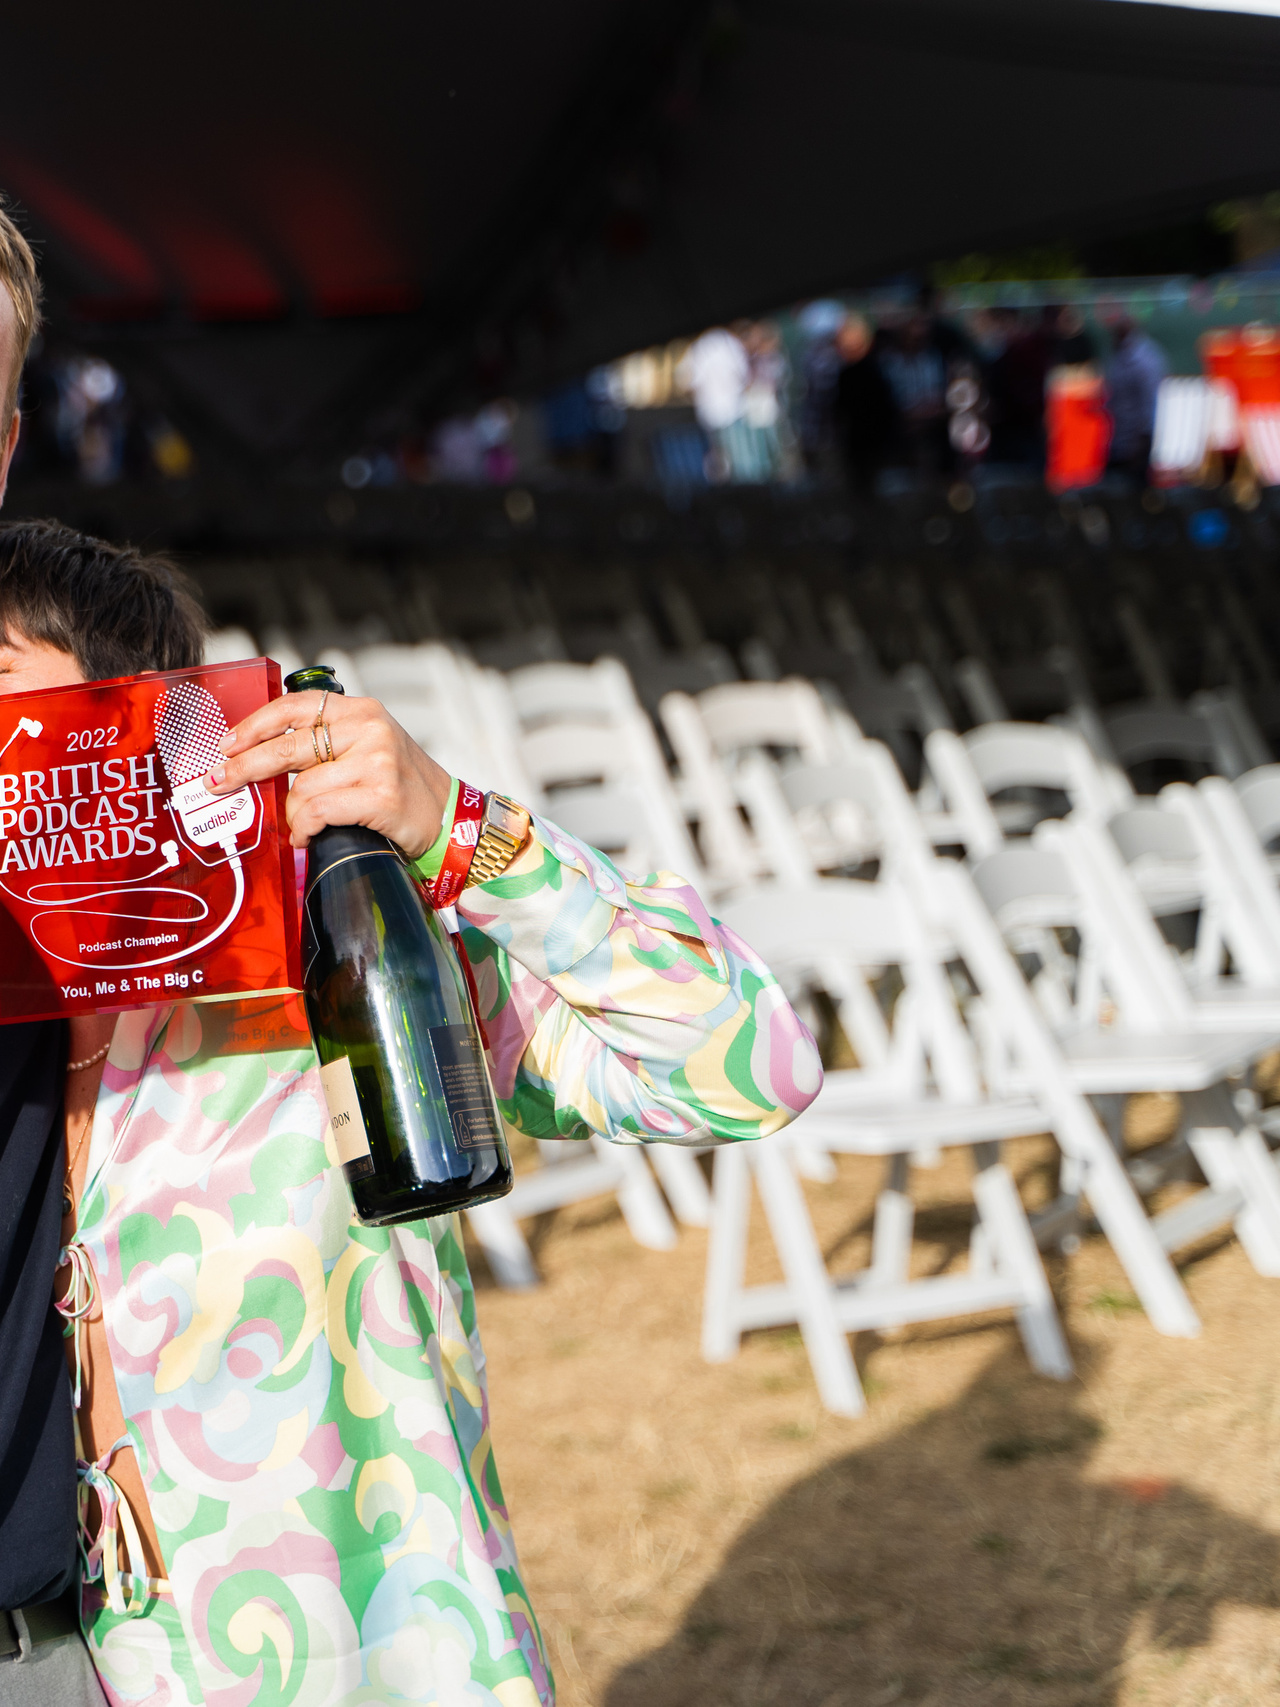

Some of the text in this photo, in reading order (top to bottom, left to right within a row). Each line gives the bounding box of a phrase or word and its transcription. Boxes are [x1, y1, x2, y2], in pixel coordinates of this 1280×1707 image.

[66, 726, 119, 752] 2022
[192, 810, 238, 836] audible
[0, 822, 157, 874] AWARDS
[438, 870, 452, 901] audible
[79, 933, 179, 953] Podcast Champion
[60, 969, 204, 998] You, Me & The Big C
